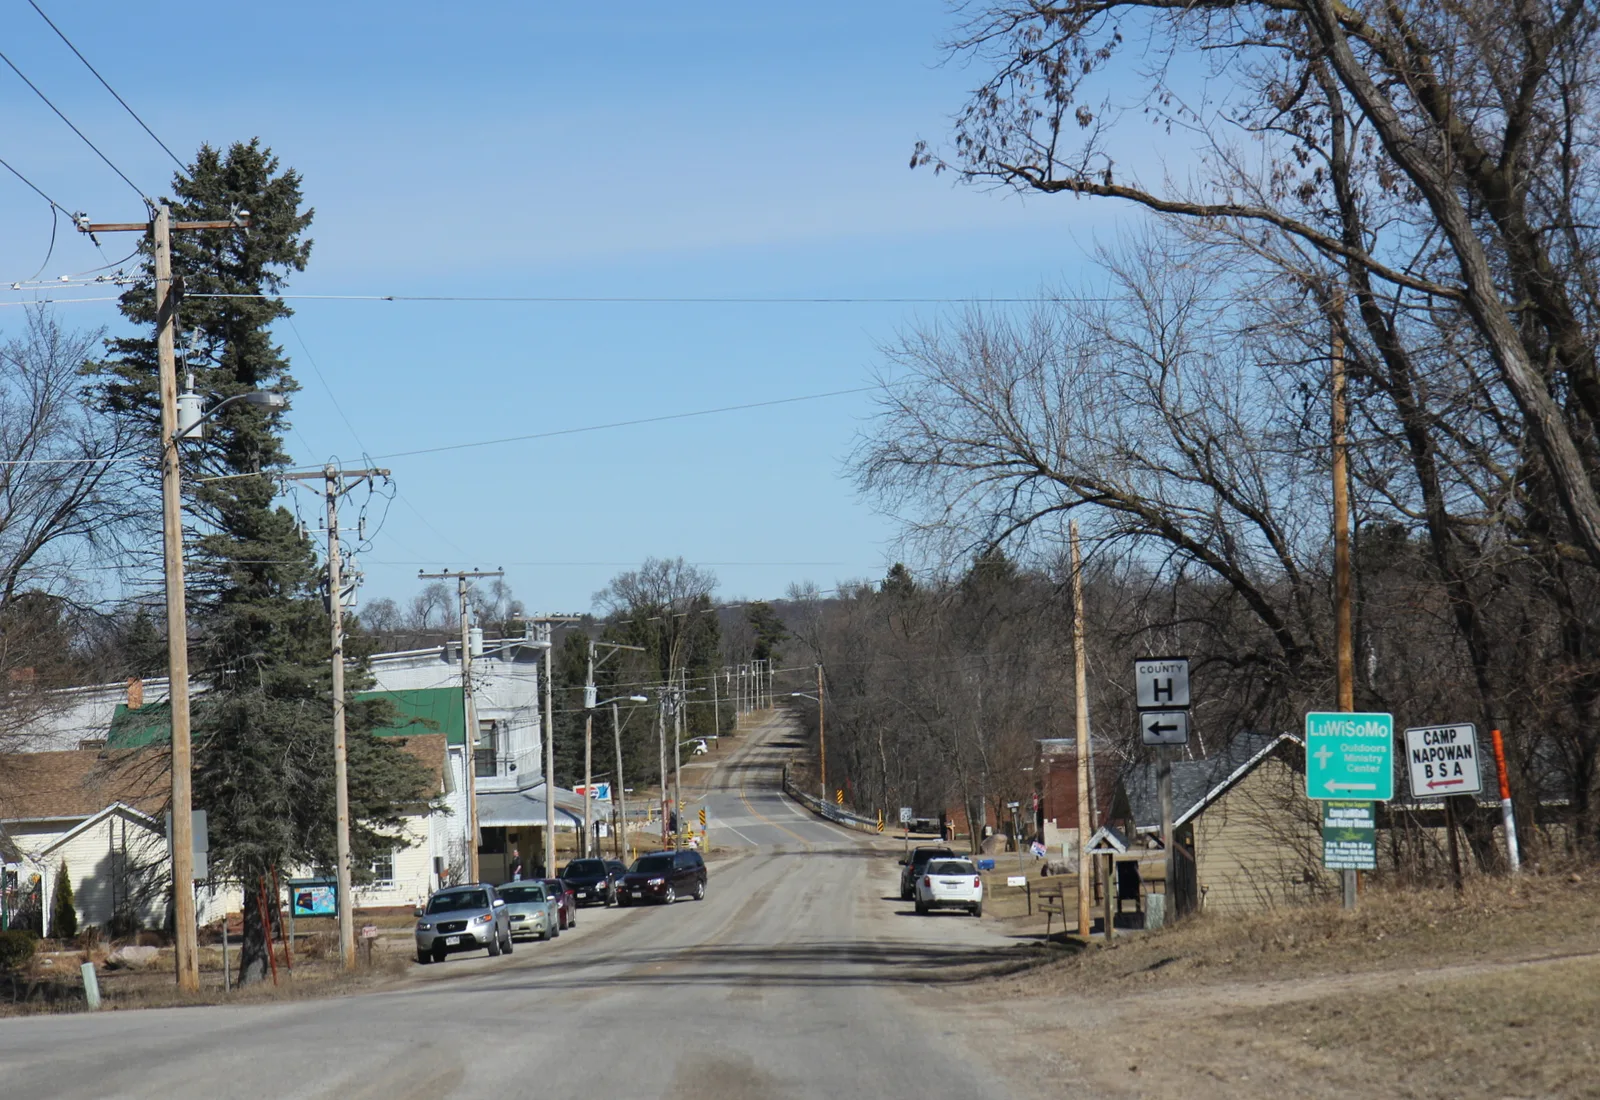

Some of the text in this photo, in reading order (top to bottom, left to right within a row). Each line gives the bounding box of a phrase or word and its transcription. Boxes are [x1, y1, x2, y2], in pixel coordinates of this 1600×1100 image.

[1140, 665, 1182, 674] COUNTY
[1154, 678, 1172, 702] H
[1310, 720, 1388, 737] LuWiSoMo
[1423, 729, 1457, 746] CAMP
[1340, 743, 1387, 753] Outdoors
[1412, 744, 1472, 764] NAPOWAN
[1344, 753, 1383, 764] Ministry
[1346, 763, 1380, 773] Center
